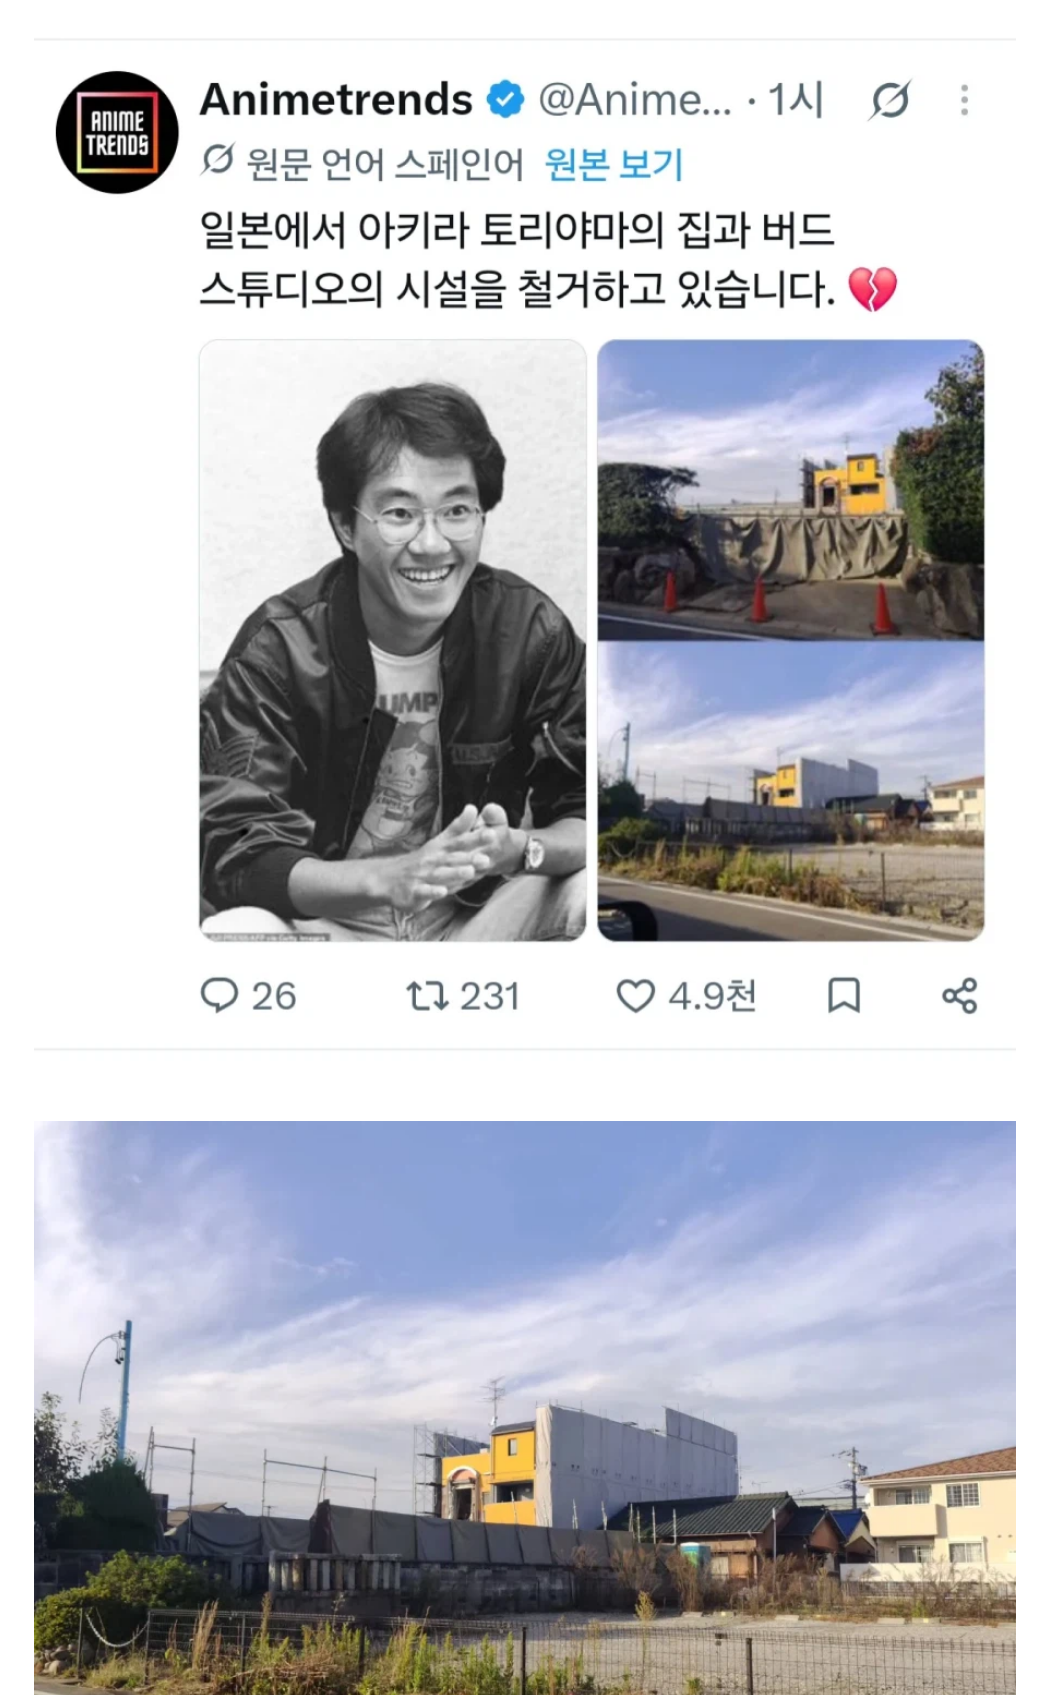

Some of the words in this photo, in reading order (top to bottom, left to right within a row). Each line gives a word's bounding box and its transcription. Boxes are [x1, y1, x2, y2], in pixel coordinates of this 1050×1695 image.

[199, 81, 472, 115] Animetrends
[540, 81, 730, 116] @Anime...
[770, 81, 821, 118] 1시
[91, 110, 144, 132] ANIME
[85, 134, 149, 156] TRENDS
[248, 148, 311, 181] 원문
[323, 148, 382, 181] 언어
[395, 148, 522, 181] 스페인어
[546, 148, 610, 181] 원본
[620, 148, 681, 181] 보기
[201, 211, 344, 249] 일본에서
[359, 211, 470, 249] 아키라
[481, 211, 662, 249] 토리야마의
[678, 211, 751, 249] 집과
[764, 211, 835, 249] 버드
[200, 270, 381, 308] 스튜디오의
[397, 270, 507, 309] 시설을
[519, 270, 665, 308] 철거하고
[679, 270, 834, 309] 있습니다.
[253, 982, 296, 1010] 26
[461, 982, 517, 1010] 231
[669, 979, 755, 1012] 4.9천
